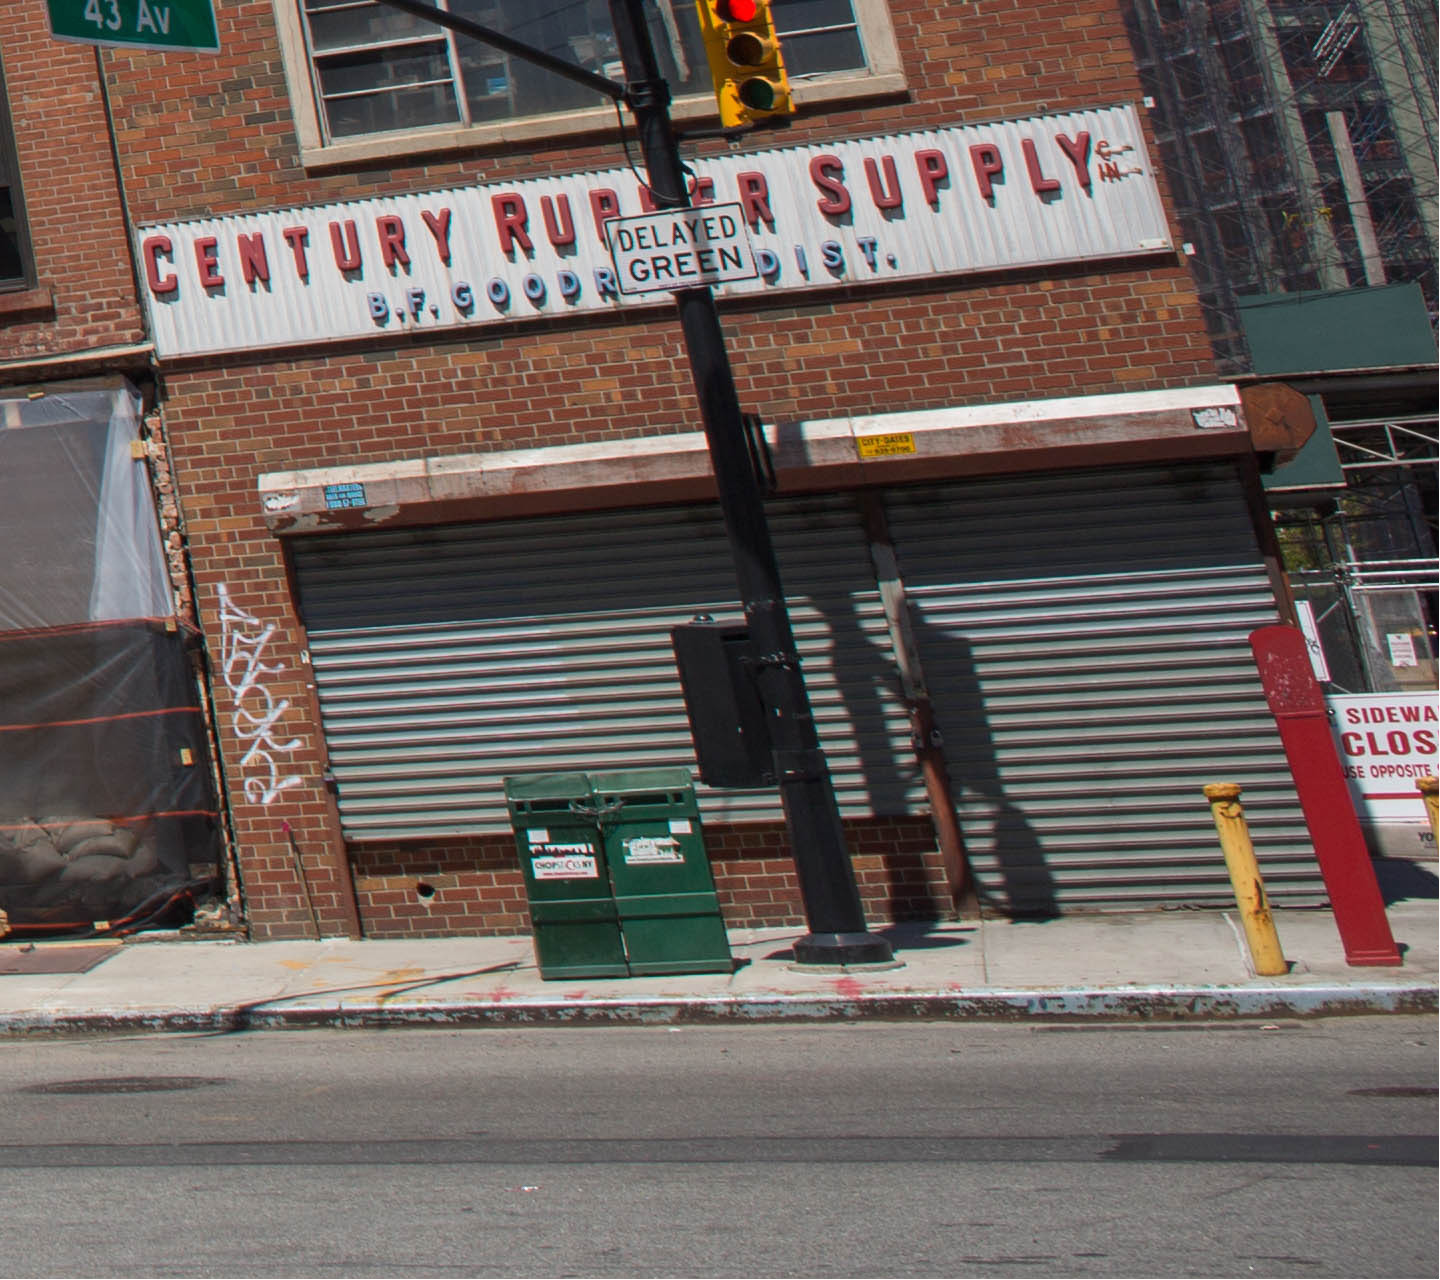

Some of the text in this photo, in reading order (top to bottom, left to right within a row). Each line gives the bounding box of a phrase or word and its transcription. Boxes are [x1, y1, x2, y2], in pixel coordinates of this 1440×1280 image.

[143, 207, 451, 294] CENTURY
[809, 130, 1091, 217] SUPPLY
[616, 215, 737, 252] DELAYED
[367, 287, 440, 320] B.F.
[754, 236, 896, 277] DIST.
[629, 245, 744, 282] GREEN
[1345, 705, 1438, 725] SIDEWA
[1341, 730, 1438, 757] CLOS
[1369, 763, 1432, 778] OPPOSITE
